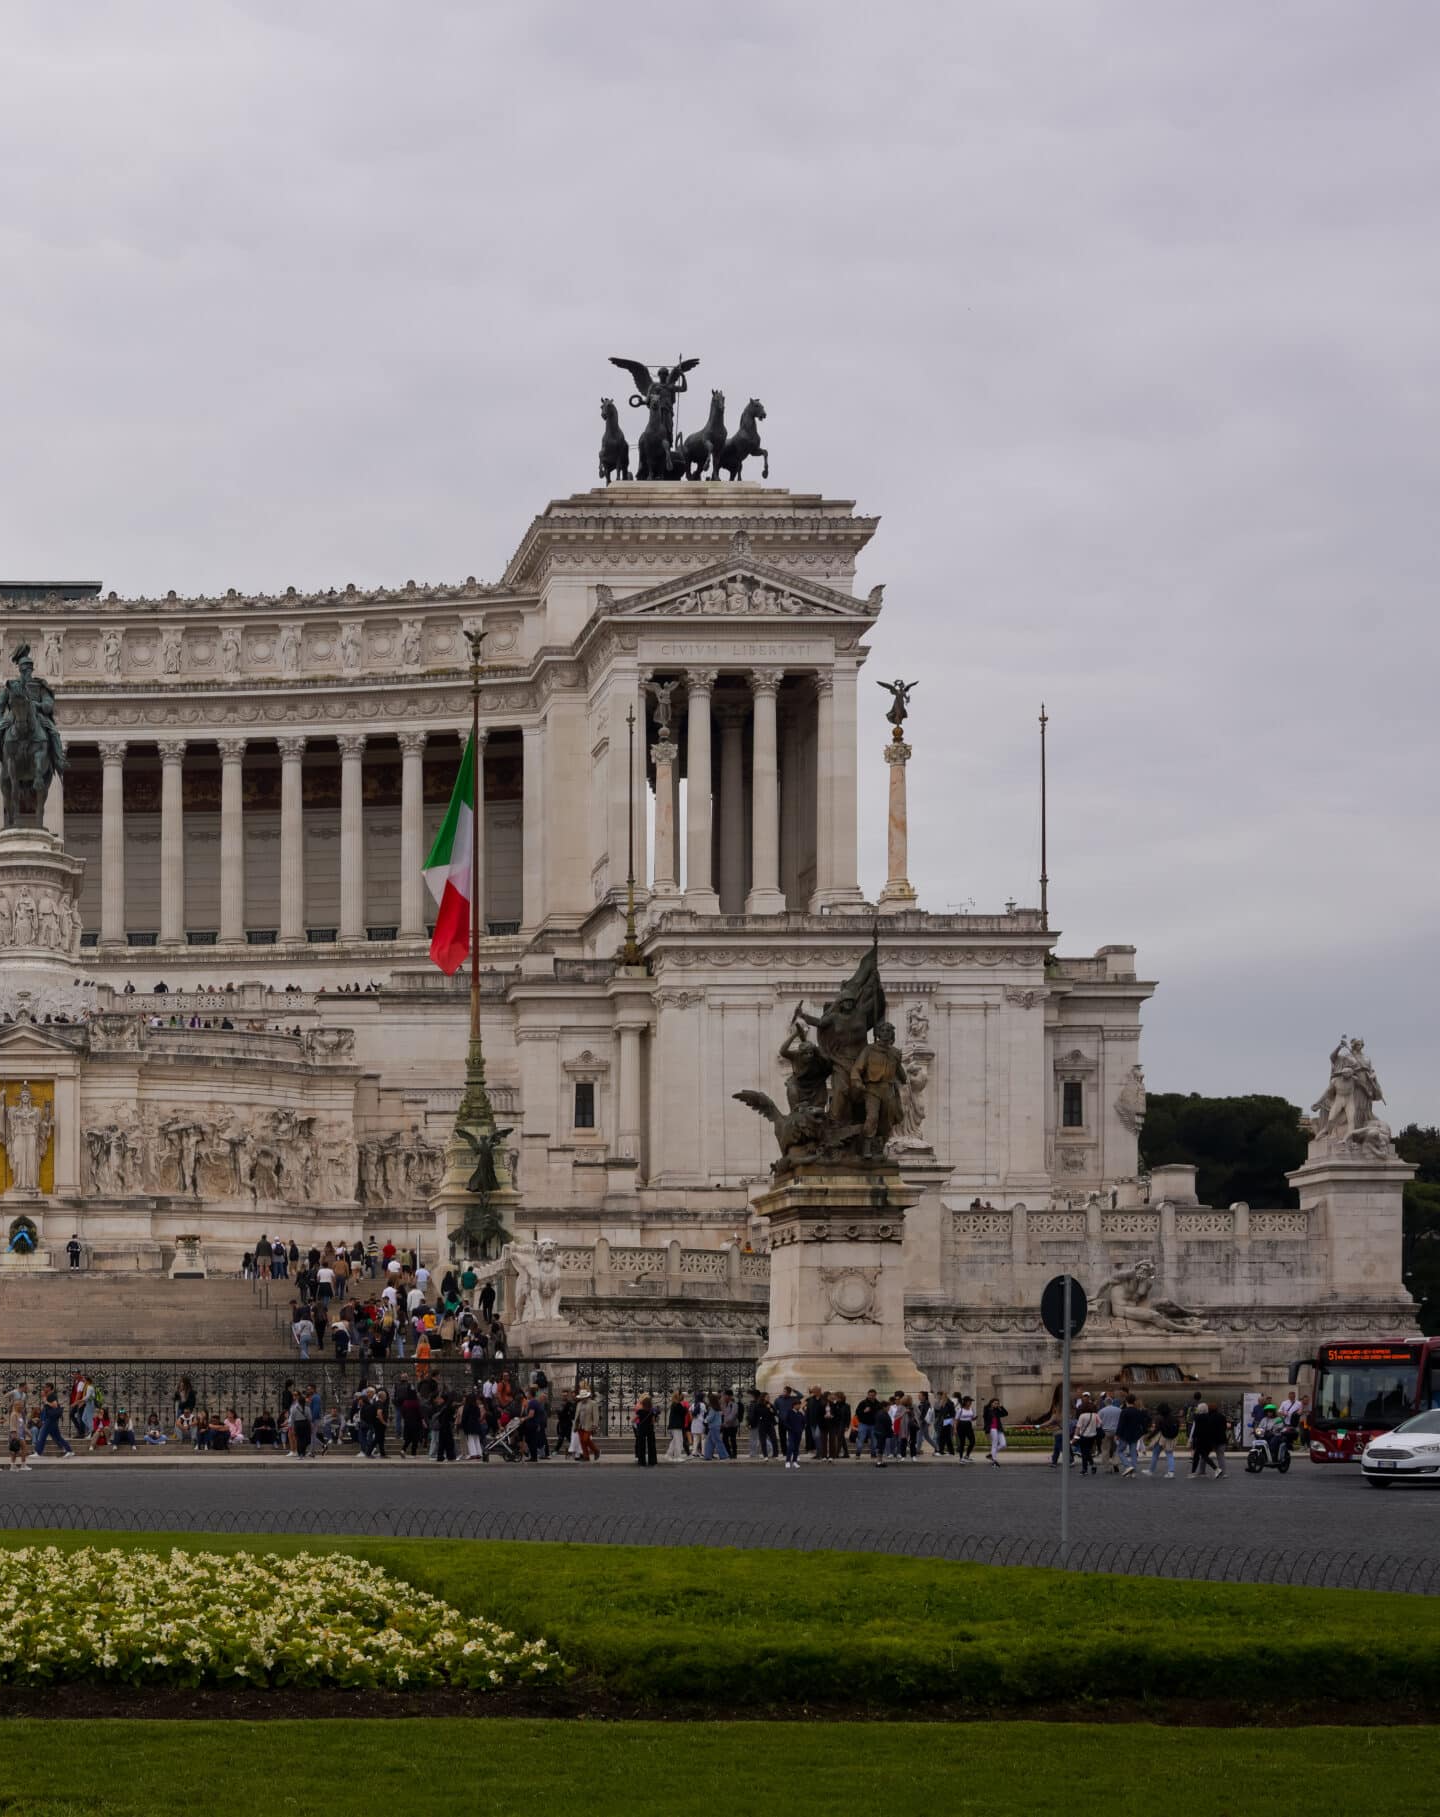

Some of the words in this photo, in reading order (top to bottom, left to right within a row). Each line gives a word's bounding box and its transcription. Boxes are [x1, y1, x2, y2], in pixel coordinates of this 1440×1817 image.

[661, 644, 718, 656] CIVIVM
[732, 644, 810, 656] LIBERTATI
[1328, 1350, 1338, 1360] 51
